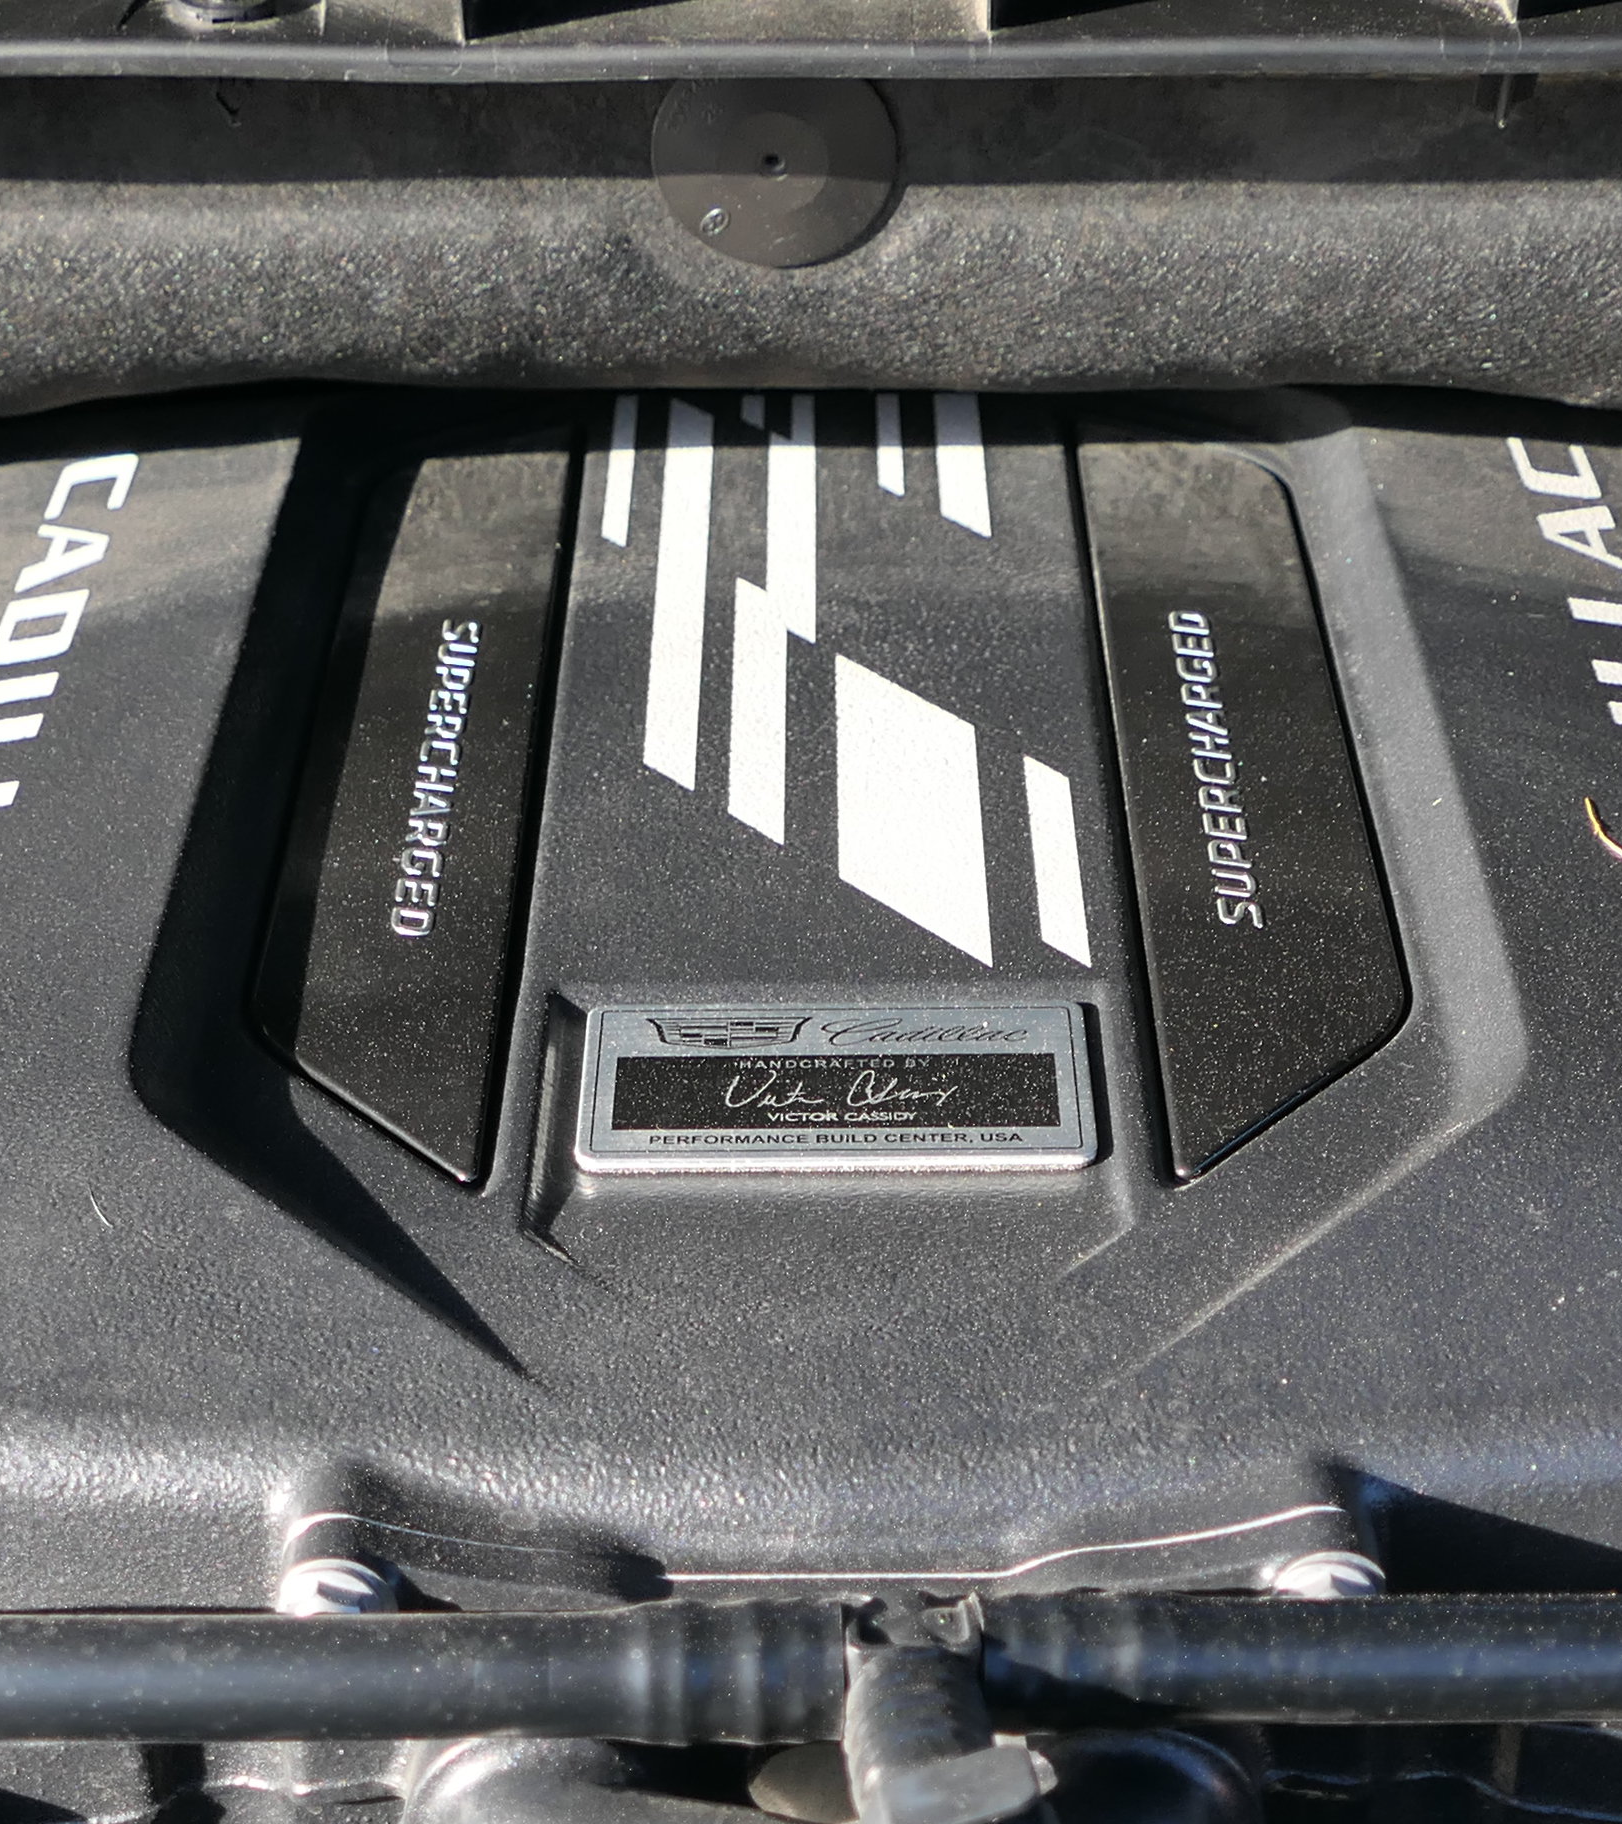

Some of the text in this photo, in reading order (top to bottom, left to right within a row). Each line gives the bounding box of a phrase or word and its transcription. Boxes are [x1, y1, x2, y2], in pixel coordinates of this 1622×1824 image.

[391, 618, 480, 938] SUPERCHARGED
[1167, 610, 1264, 930] SUPERCHARGED
[820, 1017, 1029, 1047] Cadillac
[737, 1058, 929, 1070] HANDCRAFTED BY
[766, 1110, 918, 1123] VICTOR CASSIDY
[649, 1132, 1024, 1145] PERFORMANCE BUILD CENTER, USA
